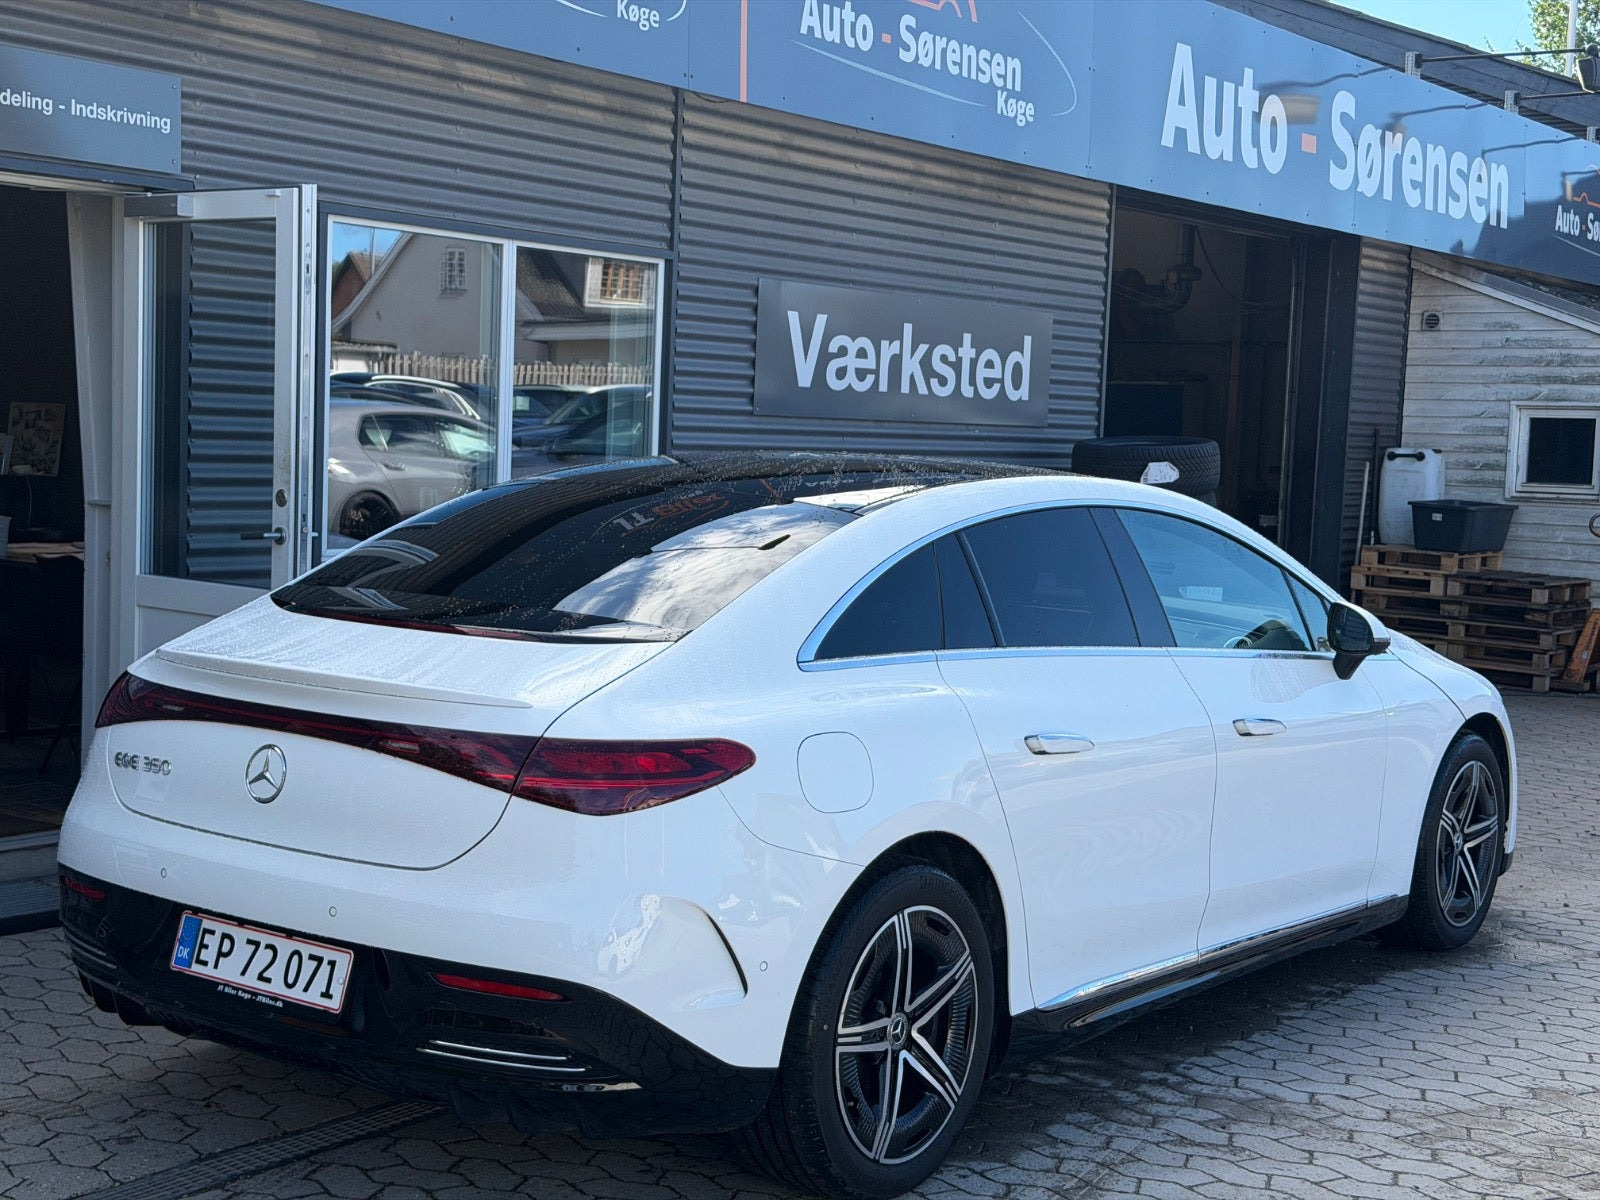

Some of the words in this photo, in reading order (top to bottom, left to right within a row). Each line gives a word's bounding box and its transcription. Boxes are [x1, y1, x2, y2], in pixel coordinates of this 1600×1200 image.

[616, 0, 660, 31] Køge
[800, 0, 874, 51] Auto
[899, 14, 1022, 92] Sørensen
[0, 88, 53, 115] deling
[71, 99, 171, 134] Indskrivning
[996, 90, 1035, 126] Køge
[1160, 42, 1288, 175] Auto
[1329, 89, 1509, 230] Sørensen
[1554, 204, 1580, 237] Auto
[787, 310, 1032, 402] Værksted
[177, 945, 190, 960] DK
[194, 927, 236, 970] EP
[239, 938, 279, 984] 72
[283, 949, 338, 1000] 071
